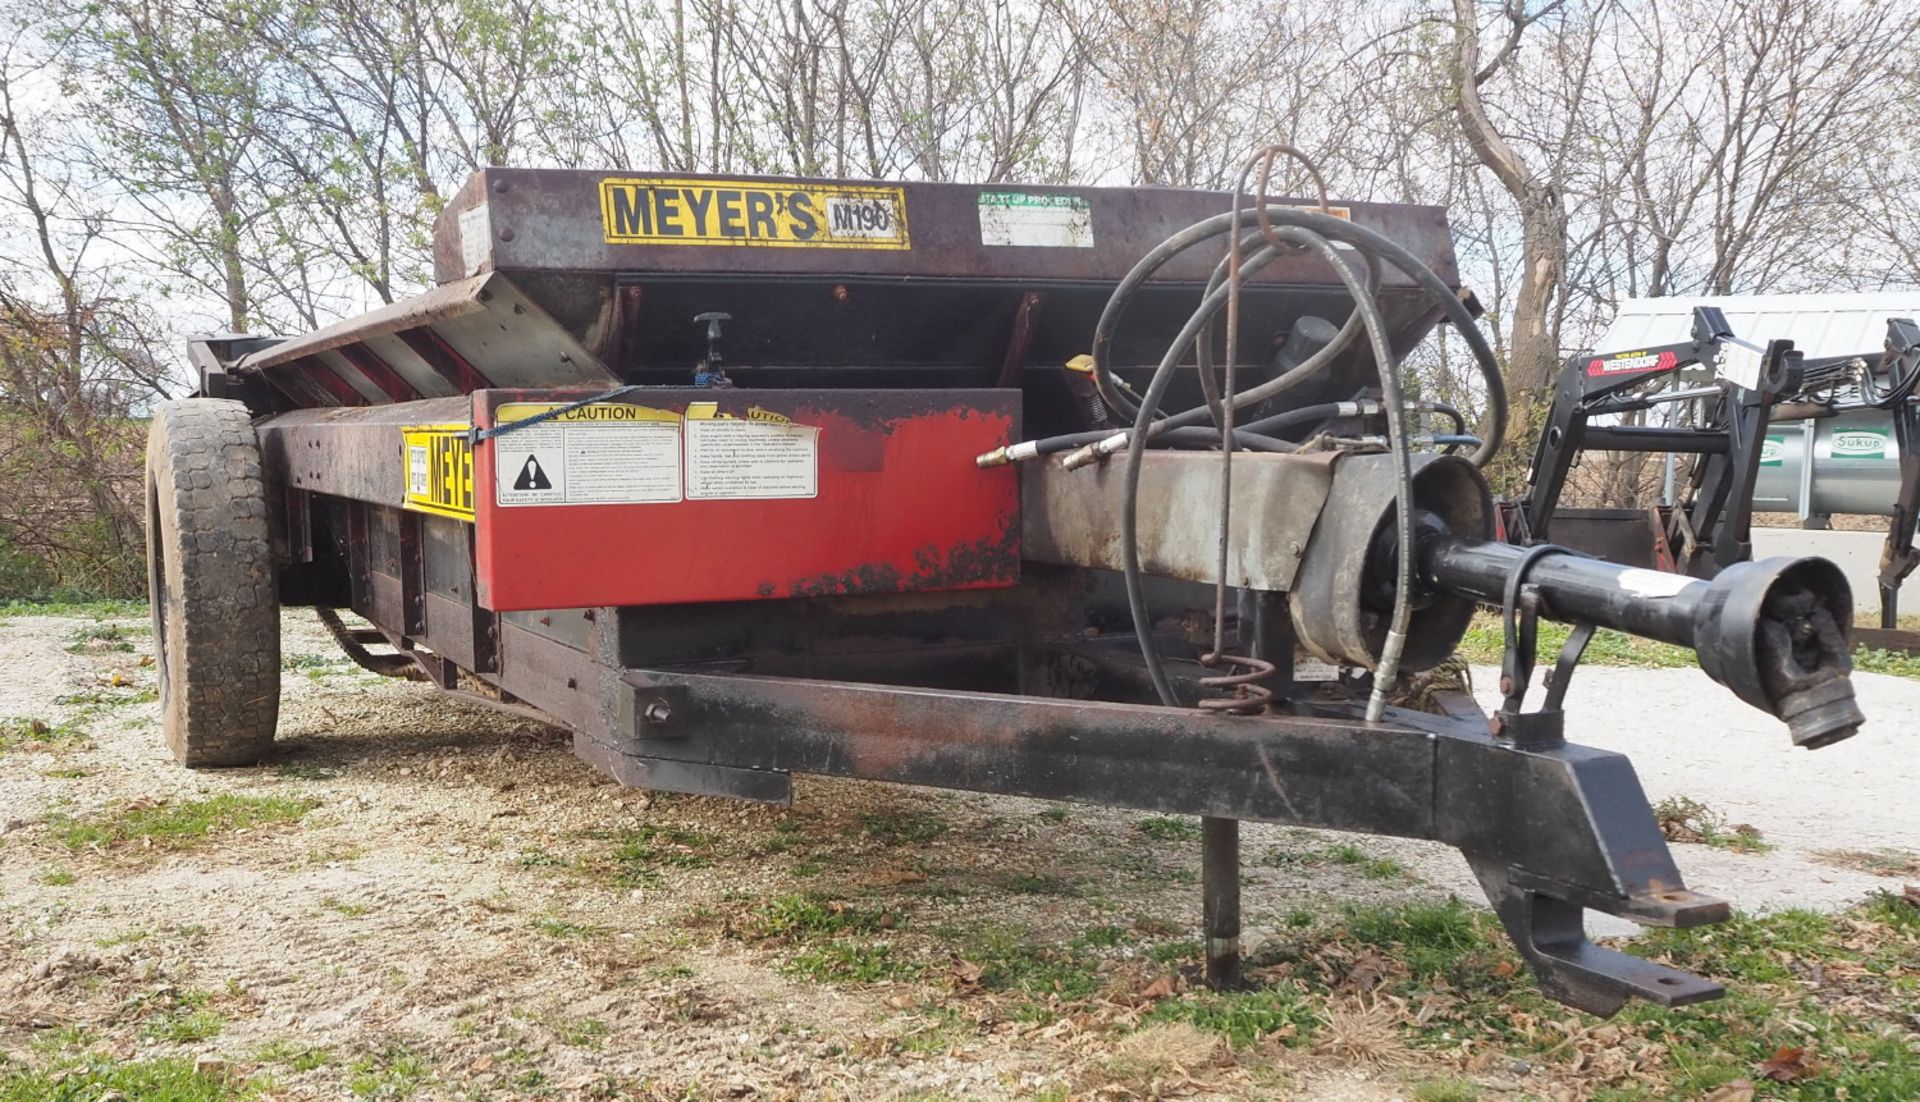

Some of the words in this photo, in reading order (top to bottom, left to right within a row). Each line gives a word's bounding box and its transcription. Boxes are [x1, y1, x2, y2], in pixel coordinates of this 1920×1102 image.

[1013, 193, 1026, 204] UP
[613, 187, 818, 240] MEYER'S
[832, 200, 890, 232] M190
[1602, 354, 1660, 371] WESTENDORF
[565, 406, 636, 420] CAUTION
[1837, 436, 1881, 448] Sukup
